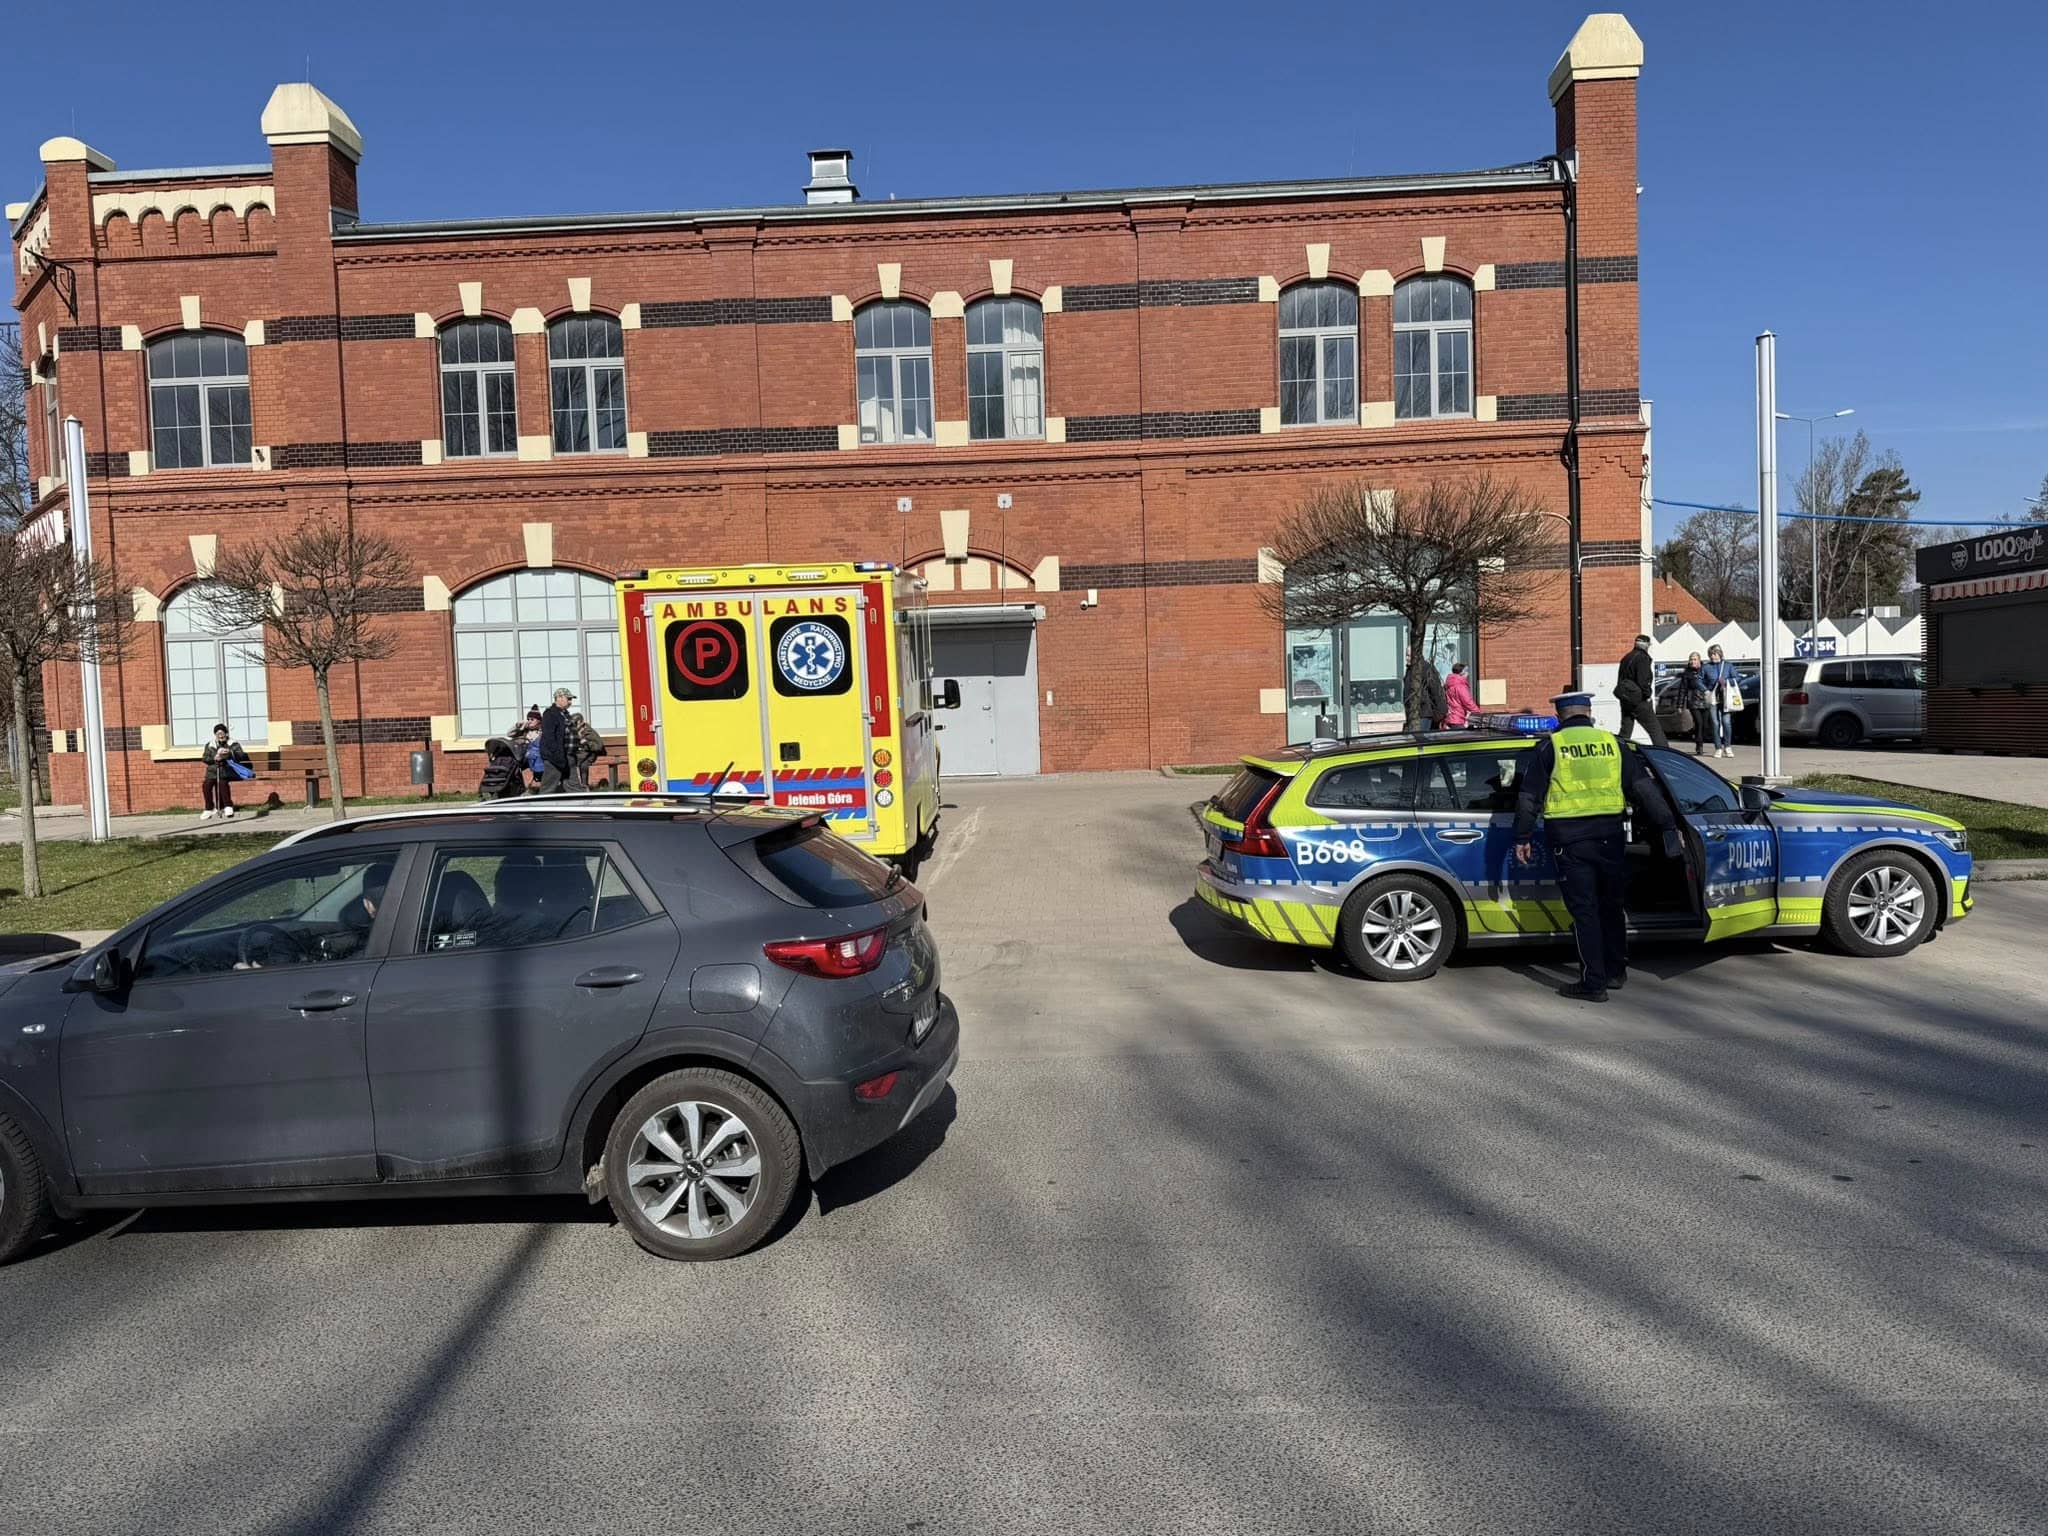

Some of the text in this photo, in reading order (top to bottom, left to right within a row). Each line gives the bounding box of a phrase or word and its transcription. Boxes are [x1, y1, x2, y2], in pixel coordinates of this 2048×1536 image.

[662, 597, 848, 619] AMBULANS
[695, 637, 721, 670] P
[809, 624, 842, 668] RATOWNICTWO
[793, 674, 833, 687] MEDYCZNE
[1559, 743, 1615, 759] POLICJA
[788, 792, 853, 806] Jelenia Góra
[1728, 839, 1772, 869] POLICJA
